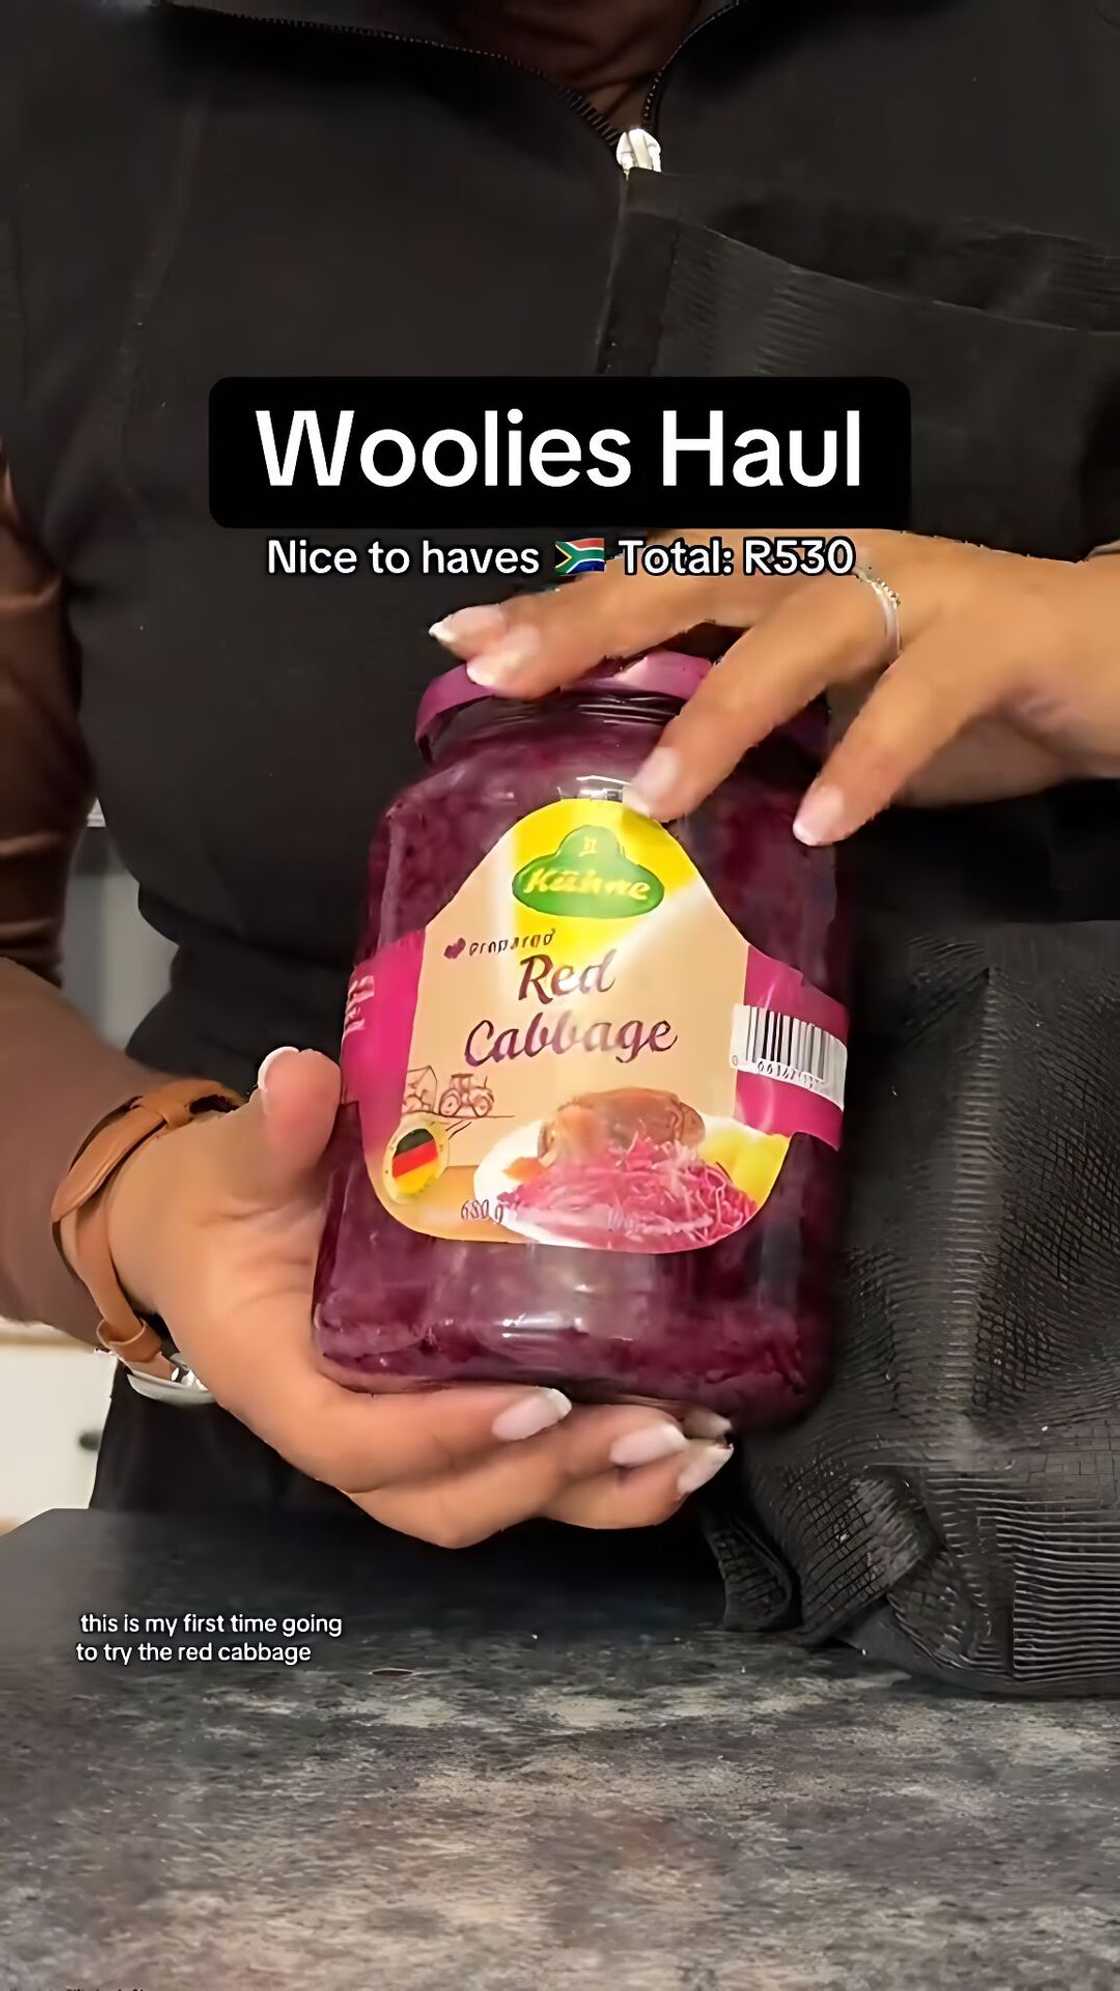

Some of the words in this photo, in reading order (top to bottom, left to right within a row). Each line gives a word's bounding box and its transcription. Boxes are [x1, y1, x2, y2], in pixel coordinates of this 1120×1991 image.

[523, 867, 651, 900] Kühne
[518, 948, 617, 1005] Red
[464, 1010, 678, 1067] Cabbage
